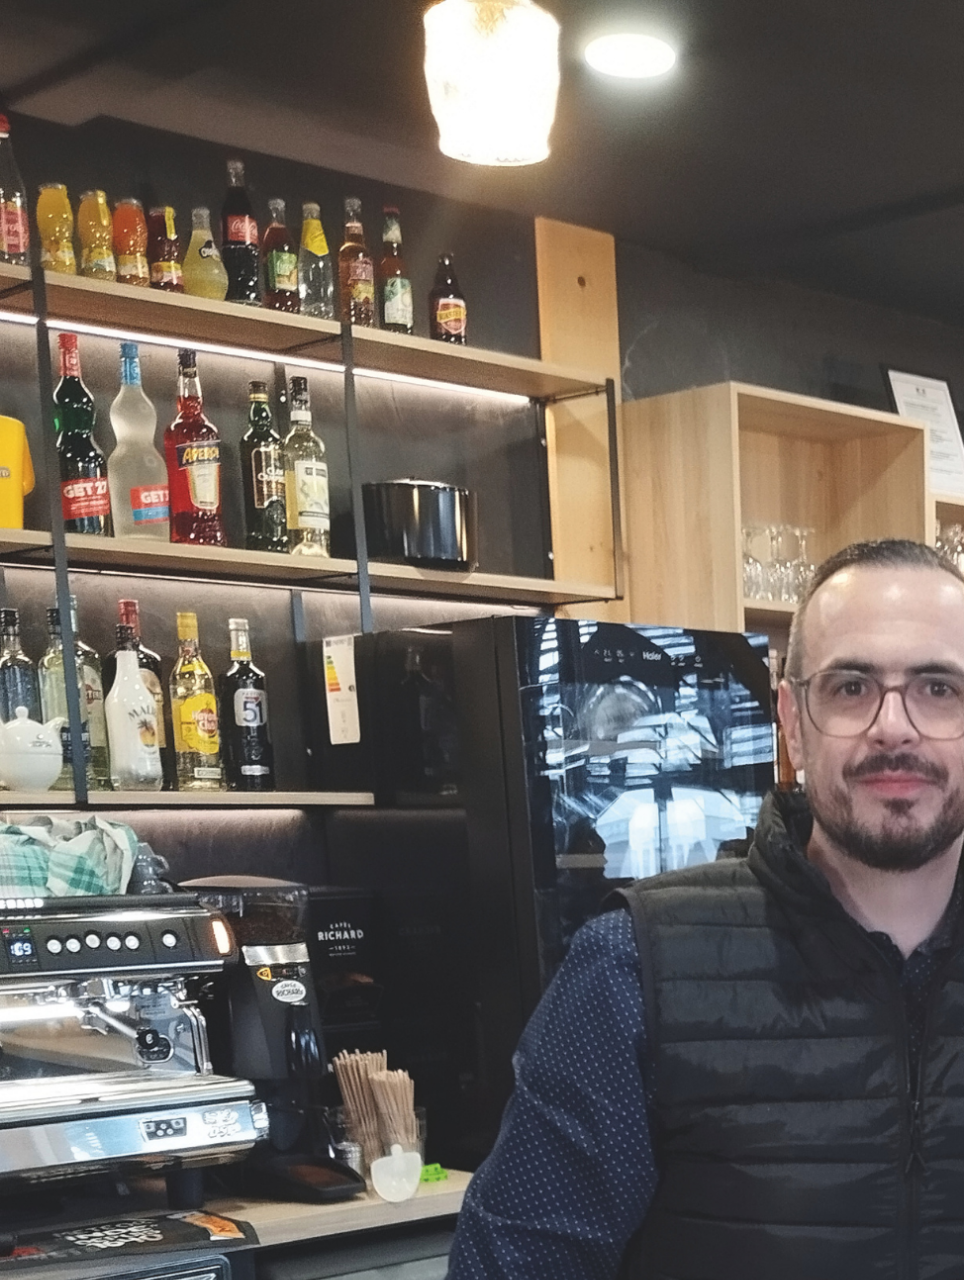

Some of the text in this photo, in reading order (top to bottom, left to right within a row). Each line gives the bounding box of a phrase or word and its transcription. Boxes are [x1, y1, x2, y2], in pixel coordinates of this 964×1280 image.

[63, 481, 107, 498] GET 27
[140, 490, 164, 504] GET
[642, 650, 662, 661] Haier
[242, 700, 263, 723] 51
[317, 929, 364, 941] RICHARD
